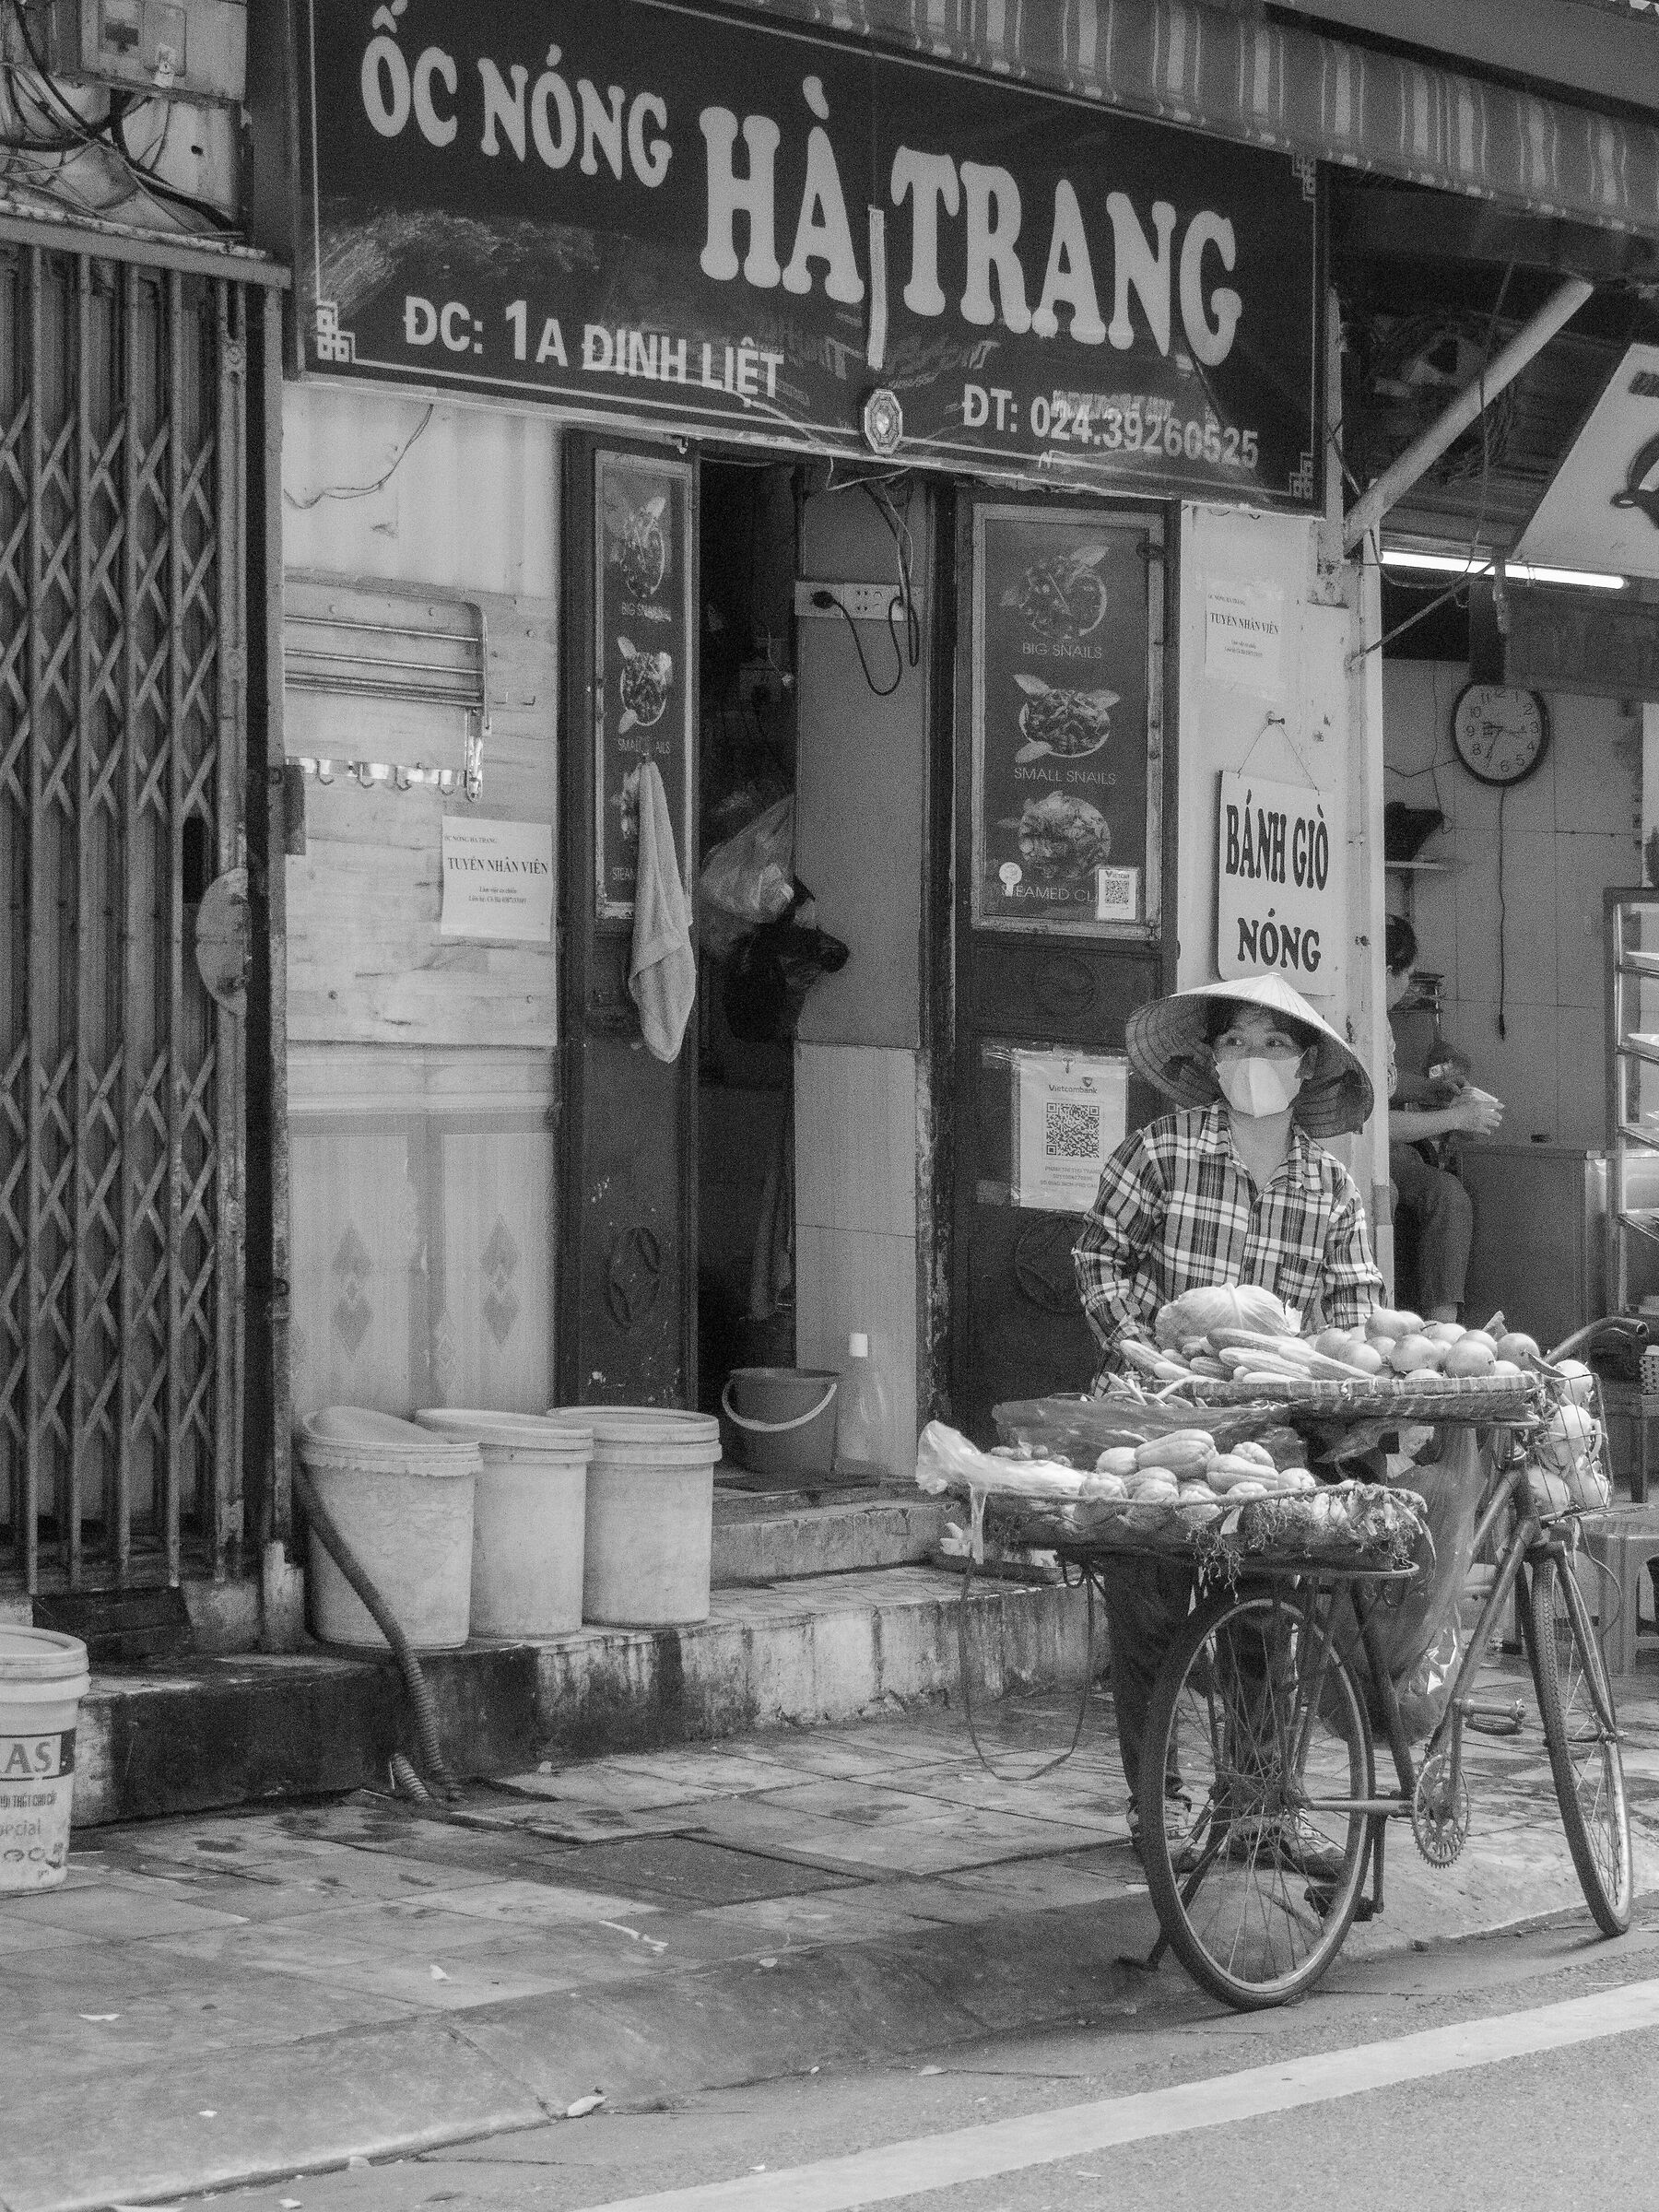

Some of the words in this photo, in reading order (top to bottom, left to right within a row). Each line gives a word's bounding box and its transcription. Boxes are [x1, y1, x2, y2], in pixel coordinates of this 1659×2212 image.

[361, 0, 457, 147] ỐC
[477, 44, 672, 187] NÓNG
[700, 76, 865, 304] HÀ
[890, 145, 1242, 367] TRANG
[403, 296, 483, 355] ĐC:
[505, 300, 569, 367] 1A
[582, 324, 688, 384] ĐINH
[961, 383, 1018, 433] ĐT:
[1030, 395, 1259, 468] 024.39260525
[1022, 642, 1048, 655] BIG
[1053, 646, 1103, 660] SNAILS
[1014, 767, 1063, 782] SMALL
[1066, 770, 1117, 785] SNAILS
[487, 856, 519, 873] NHÂN
[521, 858, 548, 875] VIÊN
[1226, 789, 1288, 885] BÁNH
[1292, 804, 1329, 891] GIÒ
[1237, 908, 1322, 973] NÓNG
[1049, 1084, 1098, 1094] Vietcombank
